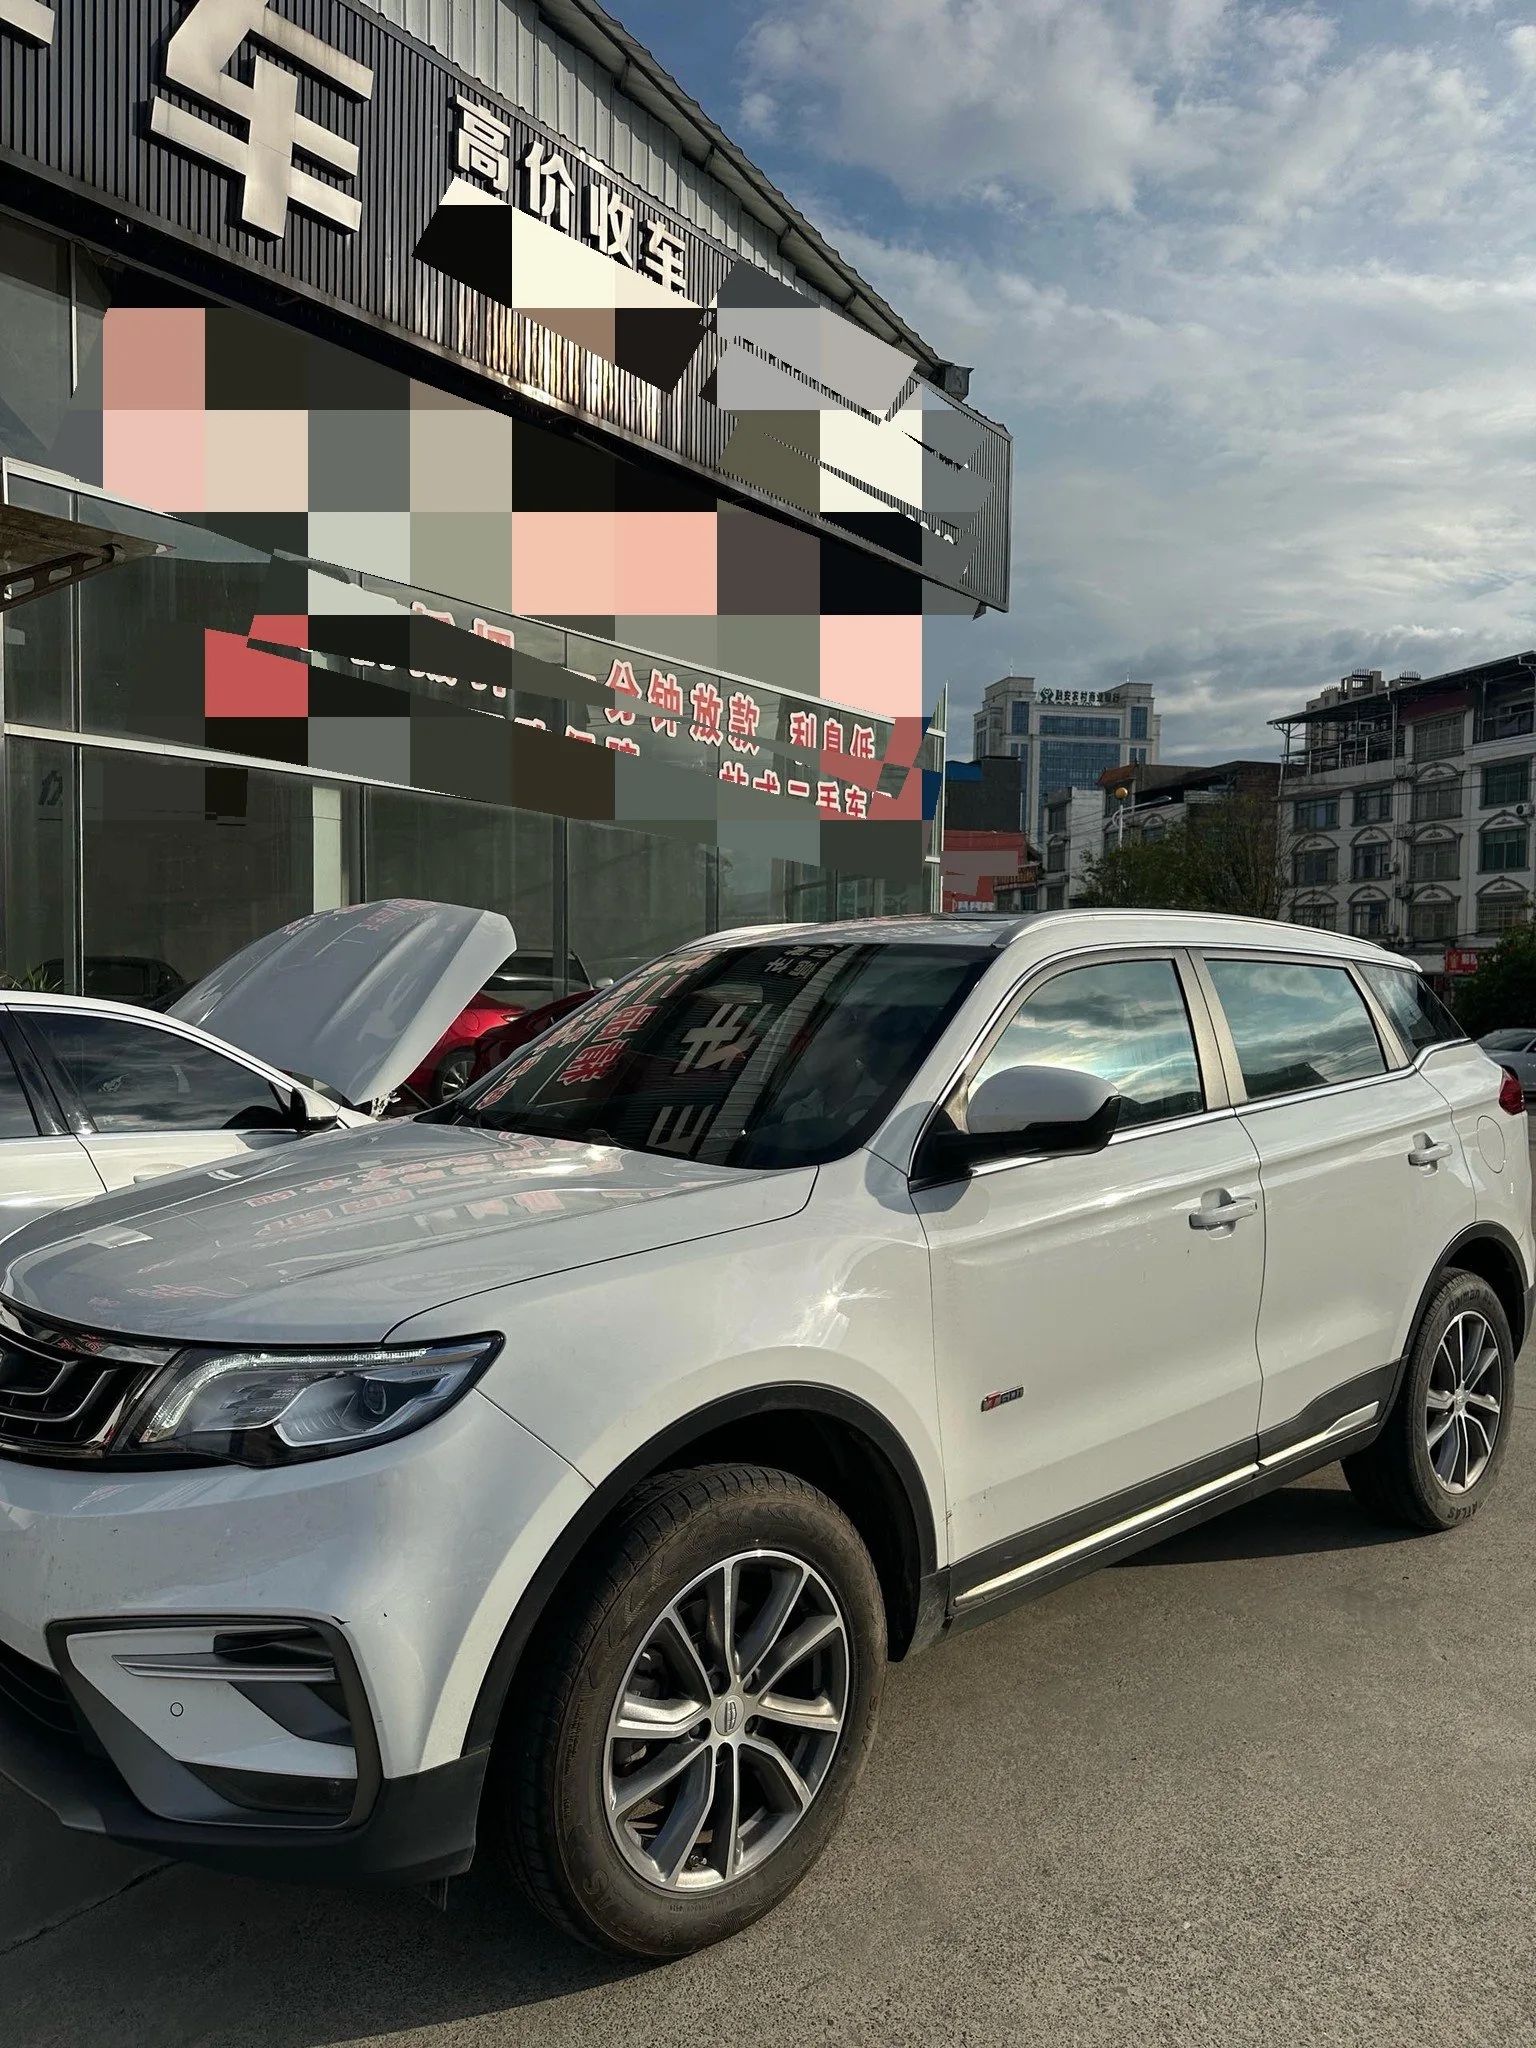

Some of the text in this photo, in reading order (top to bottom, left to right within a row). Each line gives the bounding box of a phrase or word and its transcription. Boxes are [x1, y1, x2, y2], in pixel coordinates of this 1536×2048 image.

[150, 0, 374, 239] 车
[456, 94, 688, 298] 高价收车
[411, 1366, 446, 1377] GEELY
[1447, 1500, 1478, 1520] ATLAS
